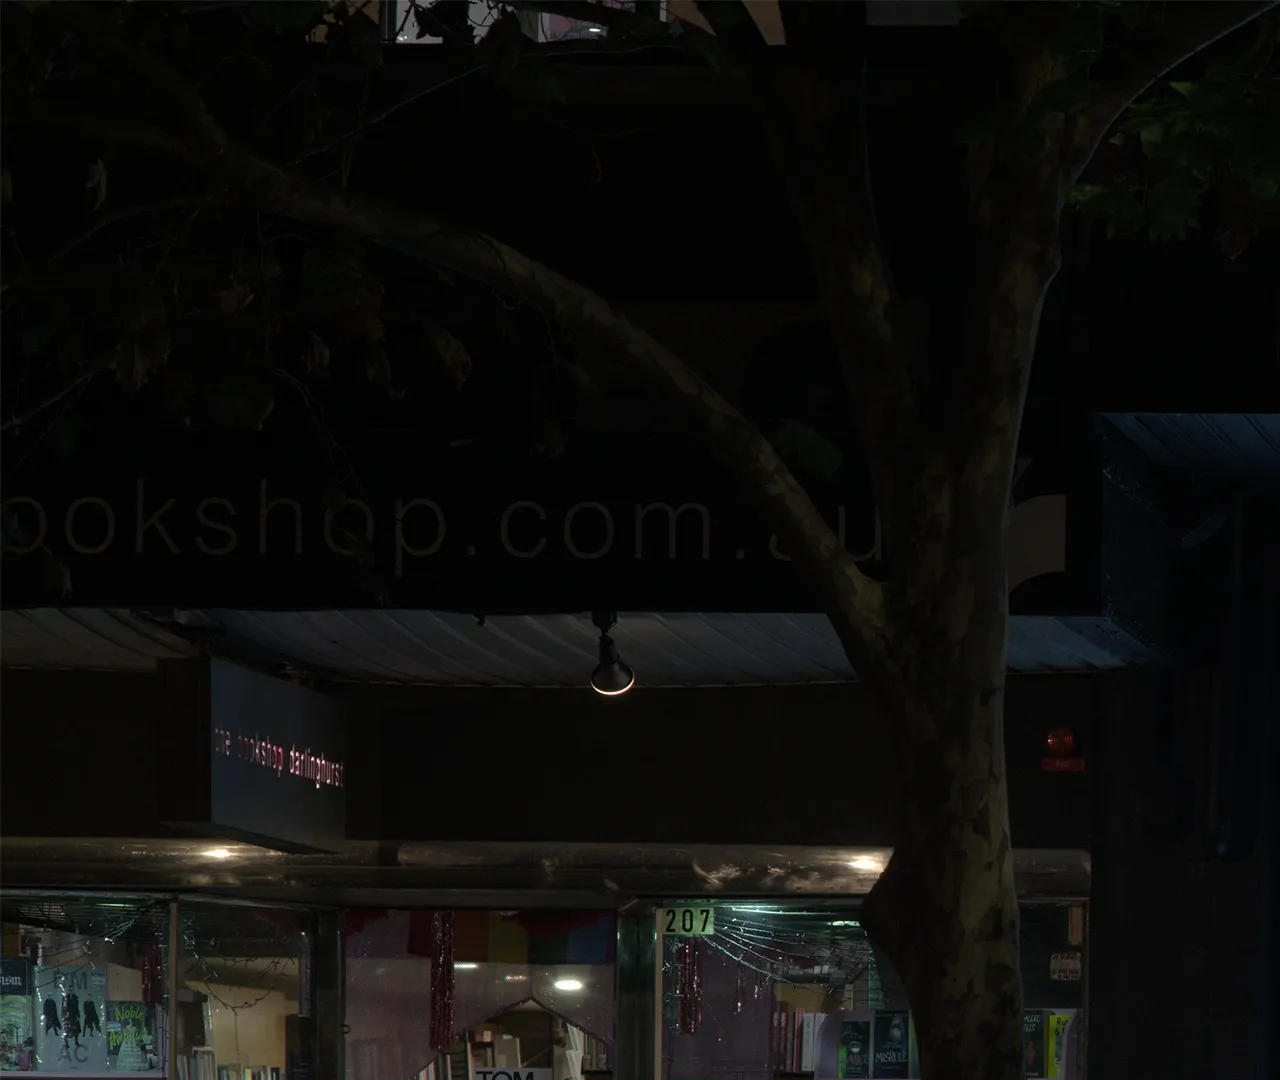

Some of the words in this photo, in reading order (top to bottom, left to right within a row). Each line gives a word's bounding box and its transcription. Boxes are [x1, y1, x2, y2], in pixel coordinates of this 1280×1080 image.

[0, 477, 885, 579] ookshop.com.u
[665, 908, 710, 933] 207
[115, 1003, 144, 1022] Noble
